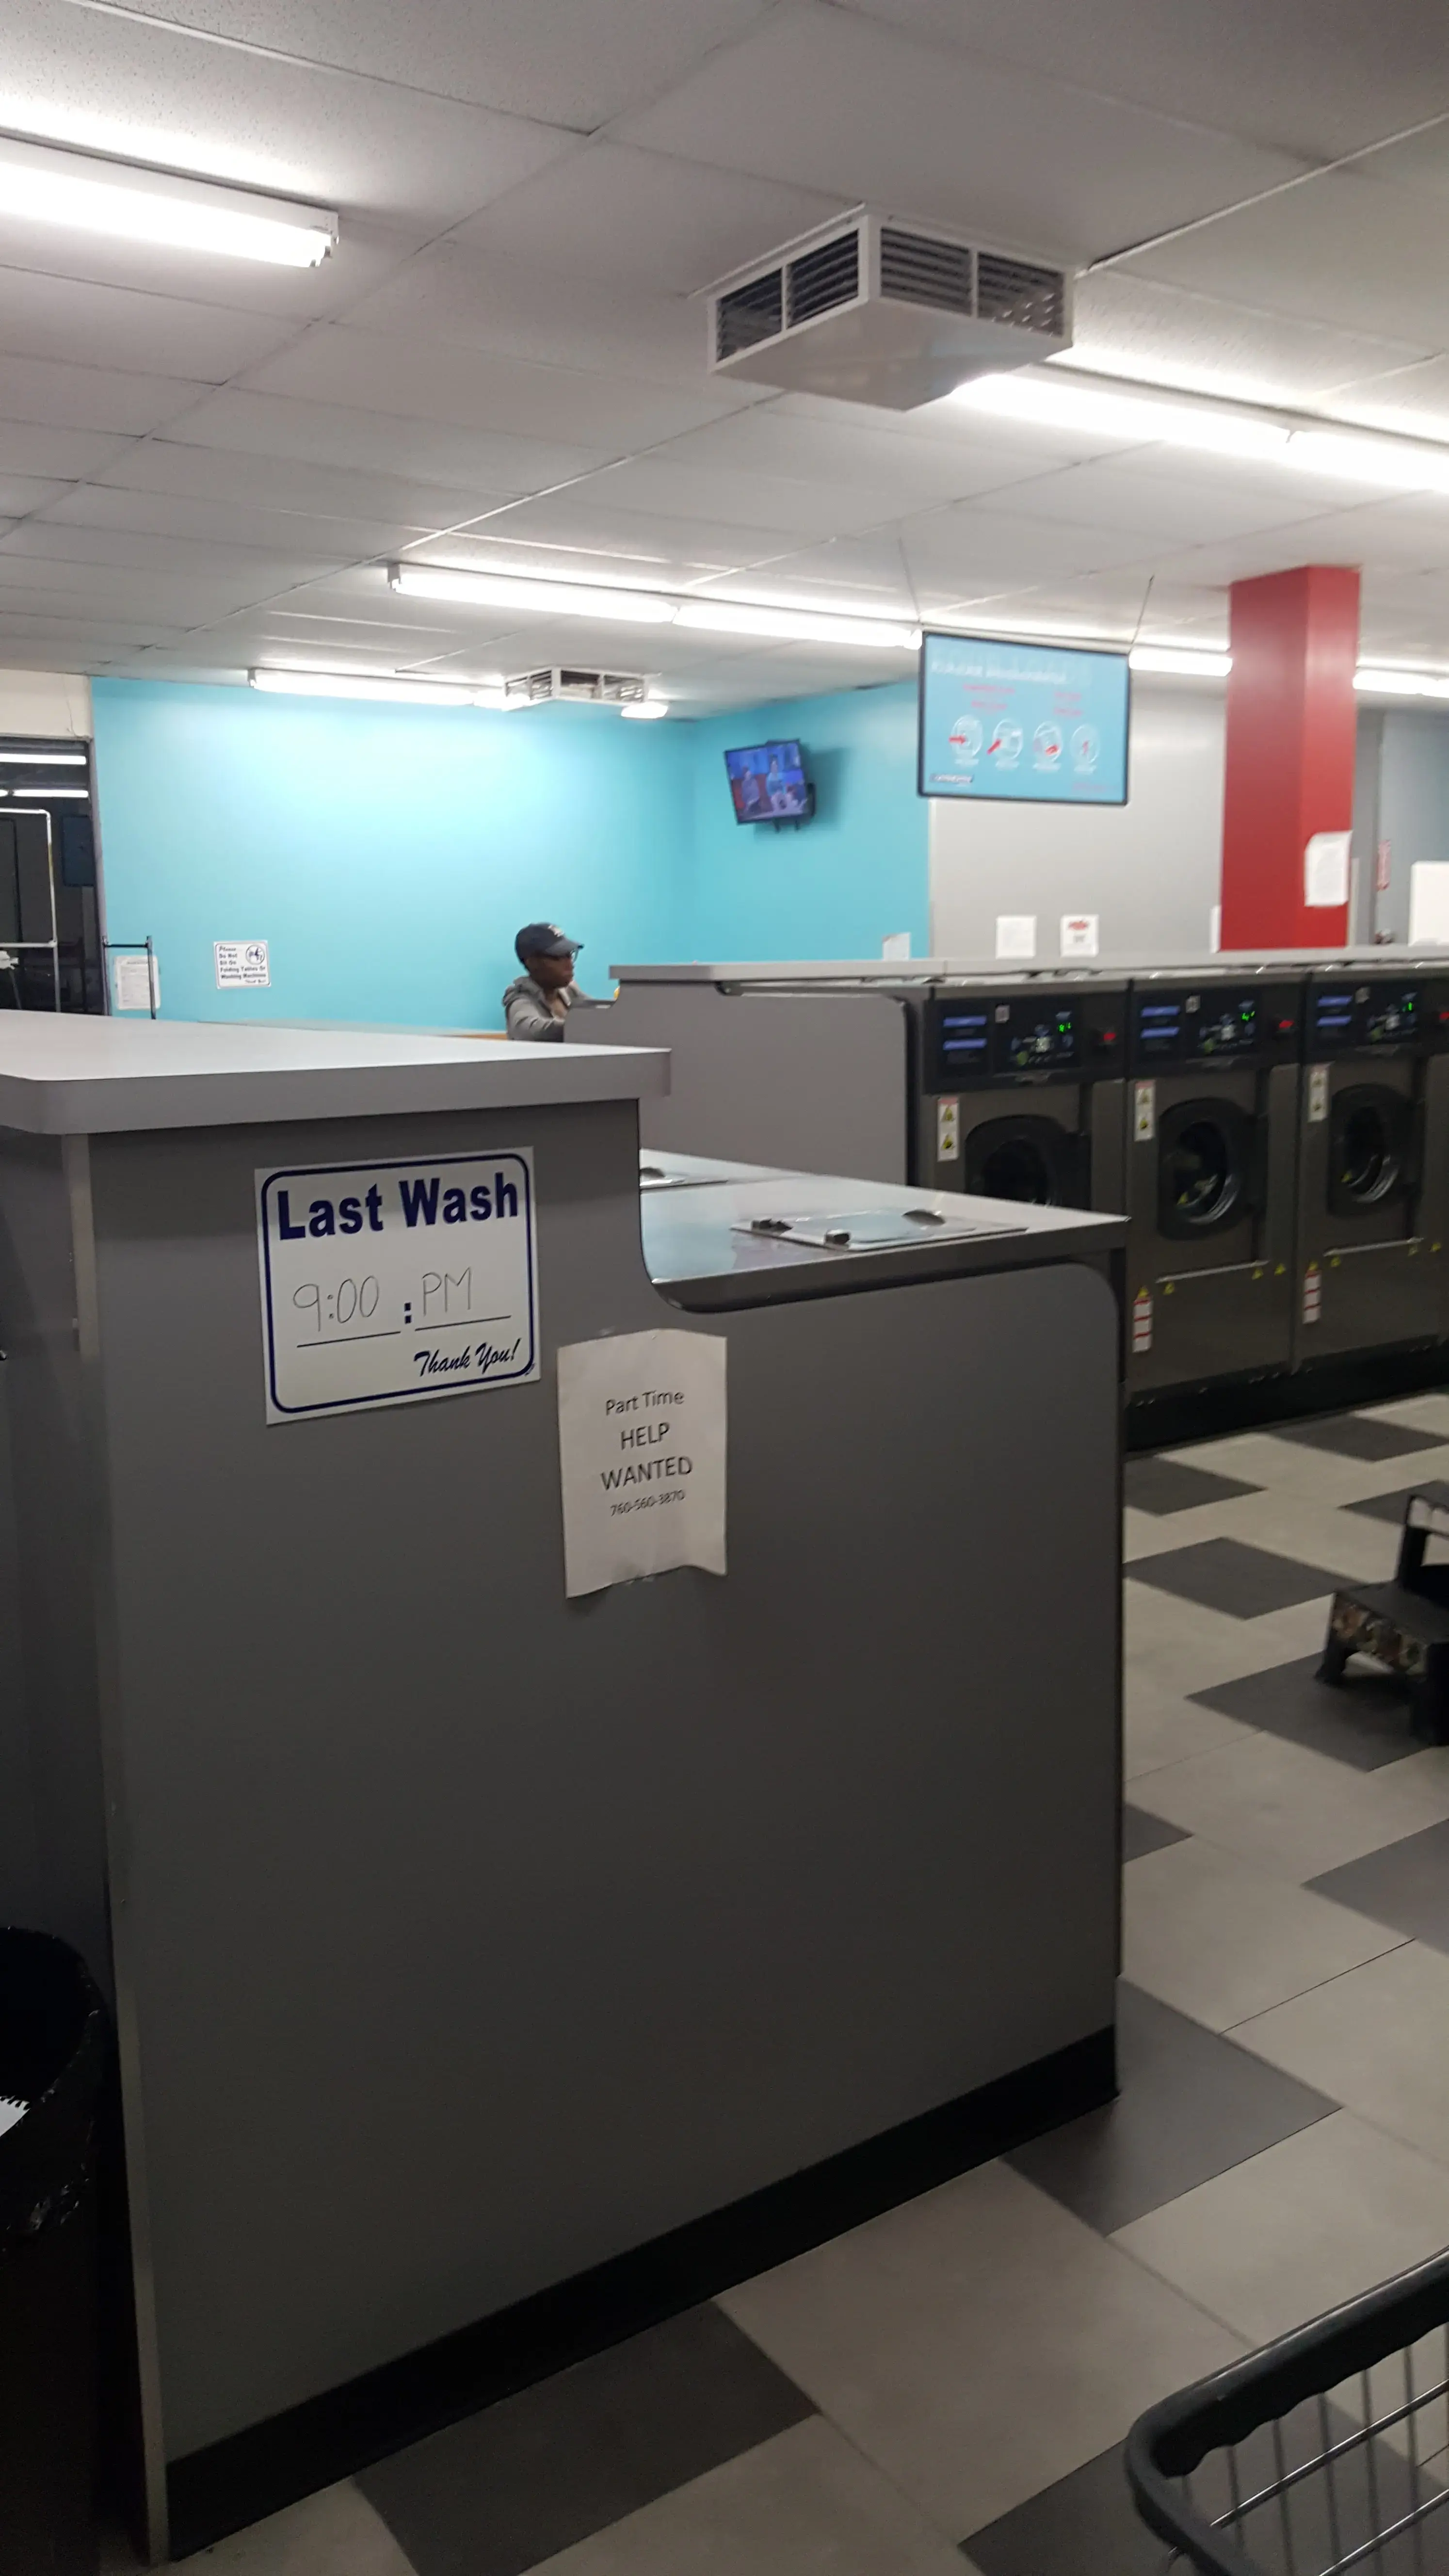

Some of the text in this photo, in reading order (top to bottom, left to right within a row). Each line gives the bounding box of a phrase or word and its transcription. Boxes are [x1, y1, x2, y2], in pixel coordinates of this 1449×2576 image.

[277, 1172, 518, 1240] Last Wash
[293, 1275, 379, 1332] 9:00
[421, 1267, 472, 1316] PM
[413, 1348, 470, 1377] Thank
[474, 1338, 522, 1374] You!
[605, 1389, 685, 1416] Part Time
[620, 1422, 670, 1450] HELP
[600, 1456, 693, 1491] WANTED
